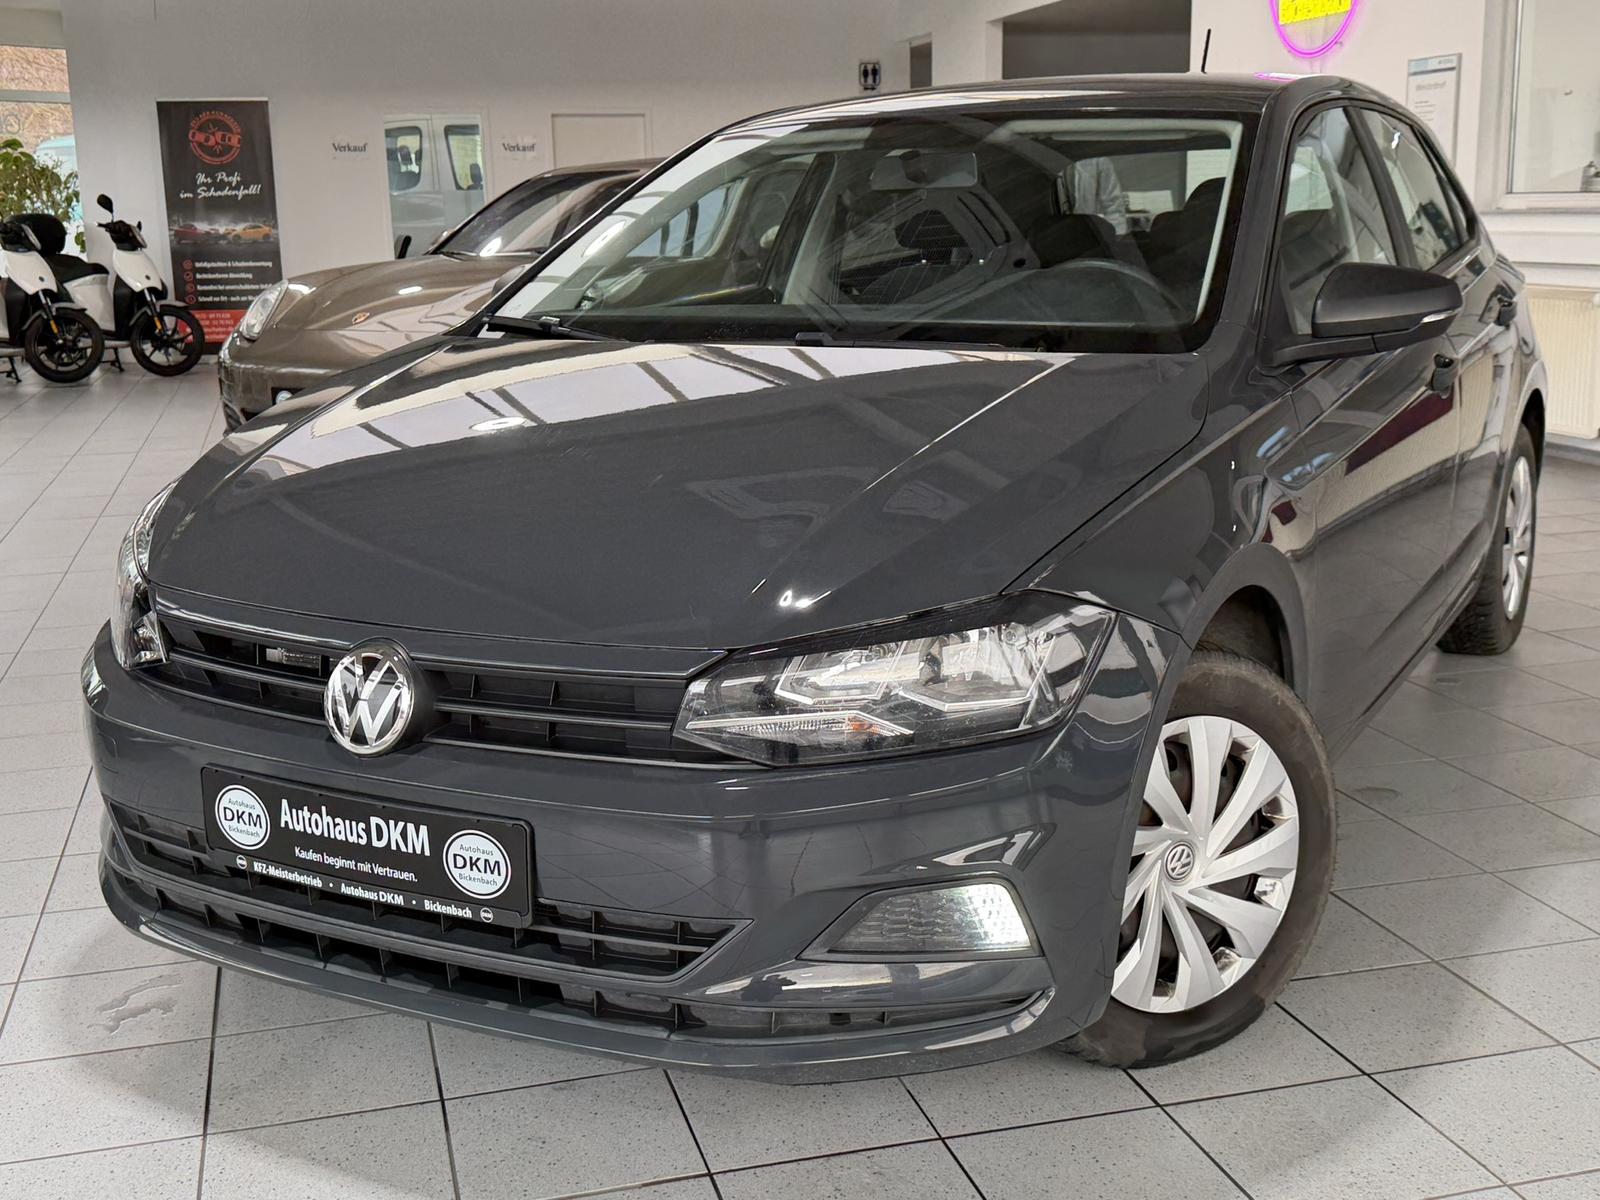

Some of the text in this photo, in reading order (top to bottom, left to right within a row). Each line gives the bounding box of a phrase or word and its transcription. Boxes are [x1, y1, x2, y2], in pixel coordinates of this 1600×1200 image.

[332, 142, 368, 153] Verkauf
[502, 142, 536, 153] Verkauf
[196, 171, 241, 187] Ihr Profi
[179, 184, 262, 200] im Schadenfall!
[228, 798, 256, 810] Autohaus
[223, 806, 263, 829] DKM
[280, 798, 430, 857] Autohaus DKM
[459, 843, 494, 856] Autohaus
[294, 846, 418, 882] Kaufen beginnt mit Vertrauen.
[452, 852, 502, 877] DKM
[458, 872, 498, 887] Bickenbach
[253, 860, 473, 919] KFZ-Meisterbetrieb Autohaus DKM Bickenbach
